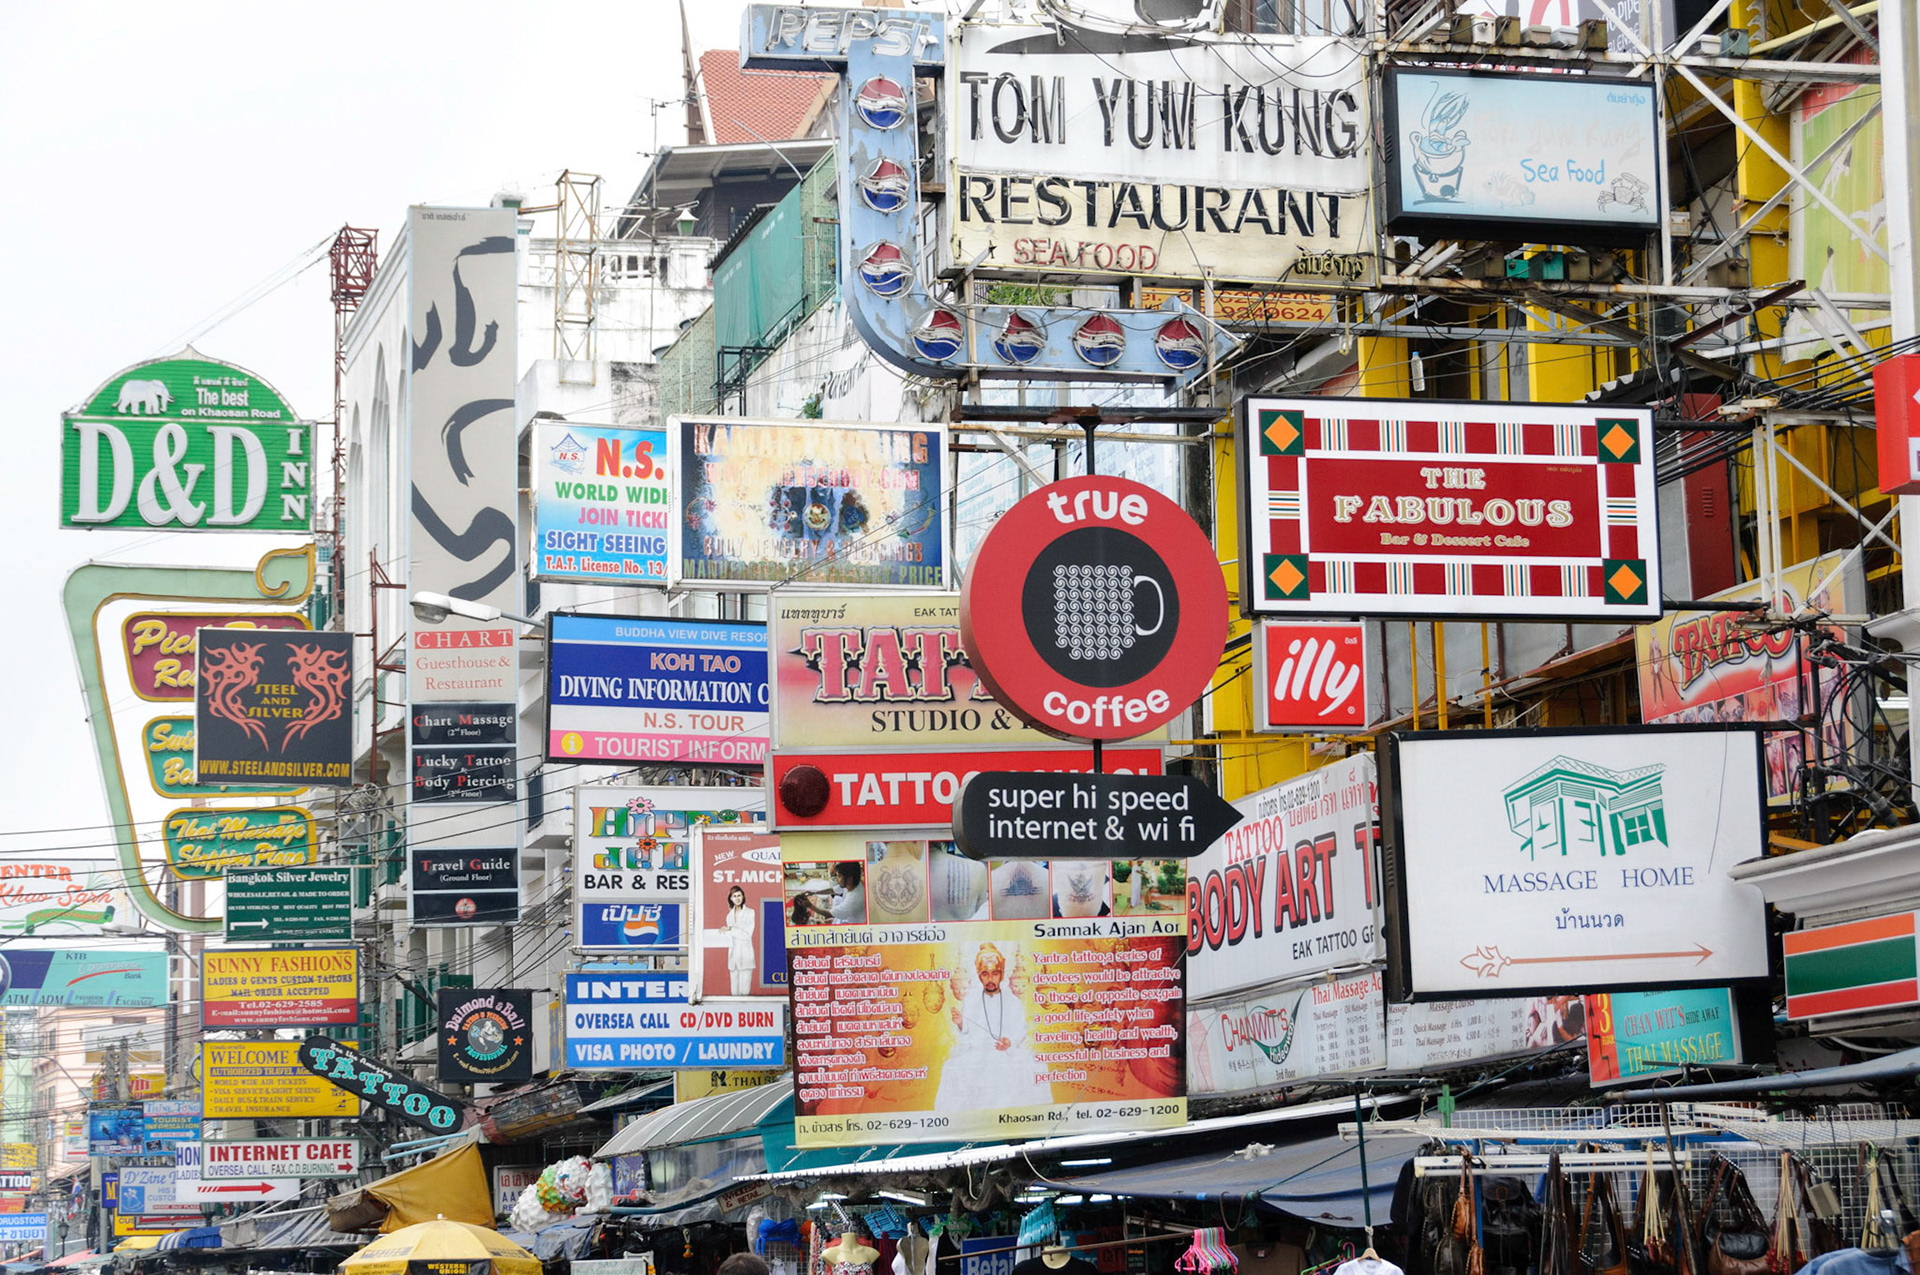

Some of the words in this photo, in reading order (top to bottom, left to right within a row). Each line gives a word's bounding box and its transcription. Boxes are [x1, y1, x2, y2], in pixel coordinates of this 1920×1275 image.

[763, 5, 930, 60] PEPSI
[960, 71, 1066, 144] TOM
[1093, 76, 1197, 150] YUM
[1224, 84, 1360, 158] KUNG
[1520, 158, 1559, 183] Sea
[959, 175, 1353, 238] RESTAURANT
[195, 387, 219, 406] The
[221, 388, 249, 406] best
[181, 408, 196, 416] on
[198, 407, 248, 418] Khaosan
[250, 409, 281, 419] Road
[596, 437, 664, 480] N.S.
[70, 422, 269, 527] D&D
[280, 428, 307, 521] INN
[1420, 466, 1486, 490] THE
[554, 481, 618, 501] WORLD
[1047, 490, 1149, 525] true
[1333, 494, 1574, 528] FABULOUS
[546, 530, 598, 551] SIGHT
[605, 534, 666, 555] SEEING
[1380, 532, 1409, 546] Bar
[1413, 532, 1427, 546] &
[1431, 533, 1491, 548] Dessert
[1494, 533, 1530, 548] Cafe
[901, 565, 943, 586] PRICE
[914, 608, 937, 617] EAK
[416, 631, 512, 648] CHART
[416, 655, 496, 670] Guesthouse
[498, 656, 511, 667] &
[650, 652, 695, 671] KOH
[699, 655, 742, 673] TAO
[425, 676, 503, 690] Restaurant
[1274, 637, 1360, 716] illy
[253, 683, 299, 695] STEEL
[560, 675, 623, 700] DIVING
[627, 677, 752, 704] INFORMATION
[260, 696, 291, 705] AND
[1043, 689, 1170, 727] coffee
[247, 707, 303, 718] SILVER
[413, 715, 452, 726] Chart
[458, 713, 514, 727] Massage
[643, 712, 683, 729] N.S.
[688, 714, 745, 732] TOUR
[871, 708, 982, 733] STUDIO
[990, 708, 1012, 731] &
[460, 728, 481, 737] Floor)
[199, 759, 350, 777] WWW.STEELANDSILVER.COM
[416, 754, 458, 769] Lucky
[464, 754, 511, 766] Tattoo
[415, 775, 450, 790] Body
[457, 774, 515, 789] Piercing
[988, 786, 1064, 819] super
[1074, 783, 1097, 807] hi
[1108, 784, 1189, 821] speed
[169, 818, 217, 843] Thai
[216, 817, 306, 844] Massage
[988, 815, 1097, 840] internet
[1104, 815, 1124, 840] &
[1138, 816, 1168, 841] wi
[1179, 815, 1196, 841] fi
[1224, 815, 1284, 865] TATTOO
[177, 844, 253, 873] Shopping
[254, 843, 306, 866] Plaza
[420, 858, 464, 872] Travel
[469, 857, 511, 870] Guide
[713, 850, 735, 861] NEW
[228, 873, 274, 885] Bangkok
[276, 872, 307, 882] Silver
[308, 871, 349, 884] Jewelry
[440, 873, 469, 882] (Ground
[471, 873, 492, 882] Floor)
[584, 874, 623, 890] BAR
[631, 875, 646, 890] &
[1483, 870, 1598, 894] MASSAGE
[1621, 866, 1694, 888] HOME
[1187, 854, 1267, 957] BODY
[1274, 831, 1337, 933] ART
[1555, 907, 1625, 930] บ้านนวด
[1033, 922, 1102, 938] Samnak
[1109, 921, 1146, 939] Ajan
[1152, 920, 1181, 934] Aor
[1292, 942, 1312, 960] EAK
[1316, 930, 1358, 955] TATTOO
[207, 956, 264, 973] SUNNY
[271, 955, 353, 972] FASHIONS
[124, 972, 142, 980] Bank
[207, 977, 238, 985] LADIES
[241, 976, 248, 984] &
[250, 976, 278, 984] GENTS
[281, 975, 314, 984] CUSTOM
[317, 974, 353, 983] TAILORS
[1033, 971, 1081, 984] devotees
[1084, 971, 1114, 982] would
[1116, 970, 1130, 981] be
[1132, 968, 1181, 981] attractive
[231, 989, 251, 997] MAIL
[254, 988, 283, 996] ORDER
[286, 987, 330, 995] ACCEPTED
[1311, 986, 1330, 1005] Thai
[1332, 980, 1369, 1000] Massage
[445, 995, 495, 1031] Daimond
[501, 1002, 526, 1030] Ball
[575, 1012, 635, 1029] OVERSEA
[639, 1012, 670, 1029] CALL
[679, 1011, 733, 1031] CD/DVD
[738, 1011, 774, 1028] BURN
[1597, 993, 1611, 1034] 3
[1624, 1012, 1652, 1037] CHAN
[1656, 1005, 1686, 1031] WIT'S
[1685, 1011, 1701, 1025] HIDE
[1702, 1006, 1720, 1021] AWAY
[1220, 1008, 1289, 1052] CHANWIT'S
[210, 1050, 289, 1064] WELCOME
[330, 1042, 343, 1051] See
[345, 1049, 358, 1061] the
[359, 1056, 394, 1079] Amazing
[575, 1043, 614, 1061] VISA
[620, 1043, 676, 1061] PHOTO
[698, 1042, 774, 1060] LAUNDRY
[1034, 1050, 1088, 1062] successful
[1091, 1050, 1100, 1060] in
[1103, 1047, 1146, 1061] business
[1149, 1045, 1169, 1057] and
[1625, 1043, 1659, 1074] THAI
[1661, 1031, 1723, 1065] MASSAGE
[211, 1067, 262, 1075] AUTHORIZED
[264, 1067, 294, 1075] TRAVEL
[1034, 1070, 1086, 1084] perfection
[309, 1047, 456, 1128] TATTOO
[210, 1144, 301, 1162] INTERNET
[306, 1143, 352, 1160] CAFE
